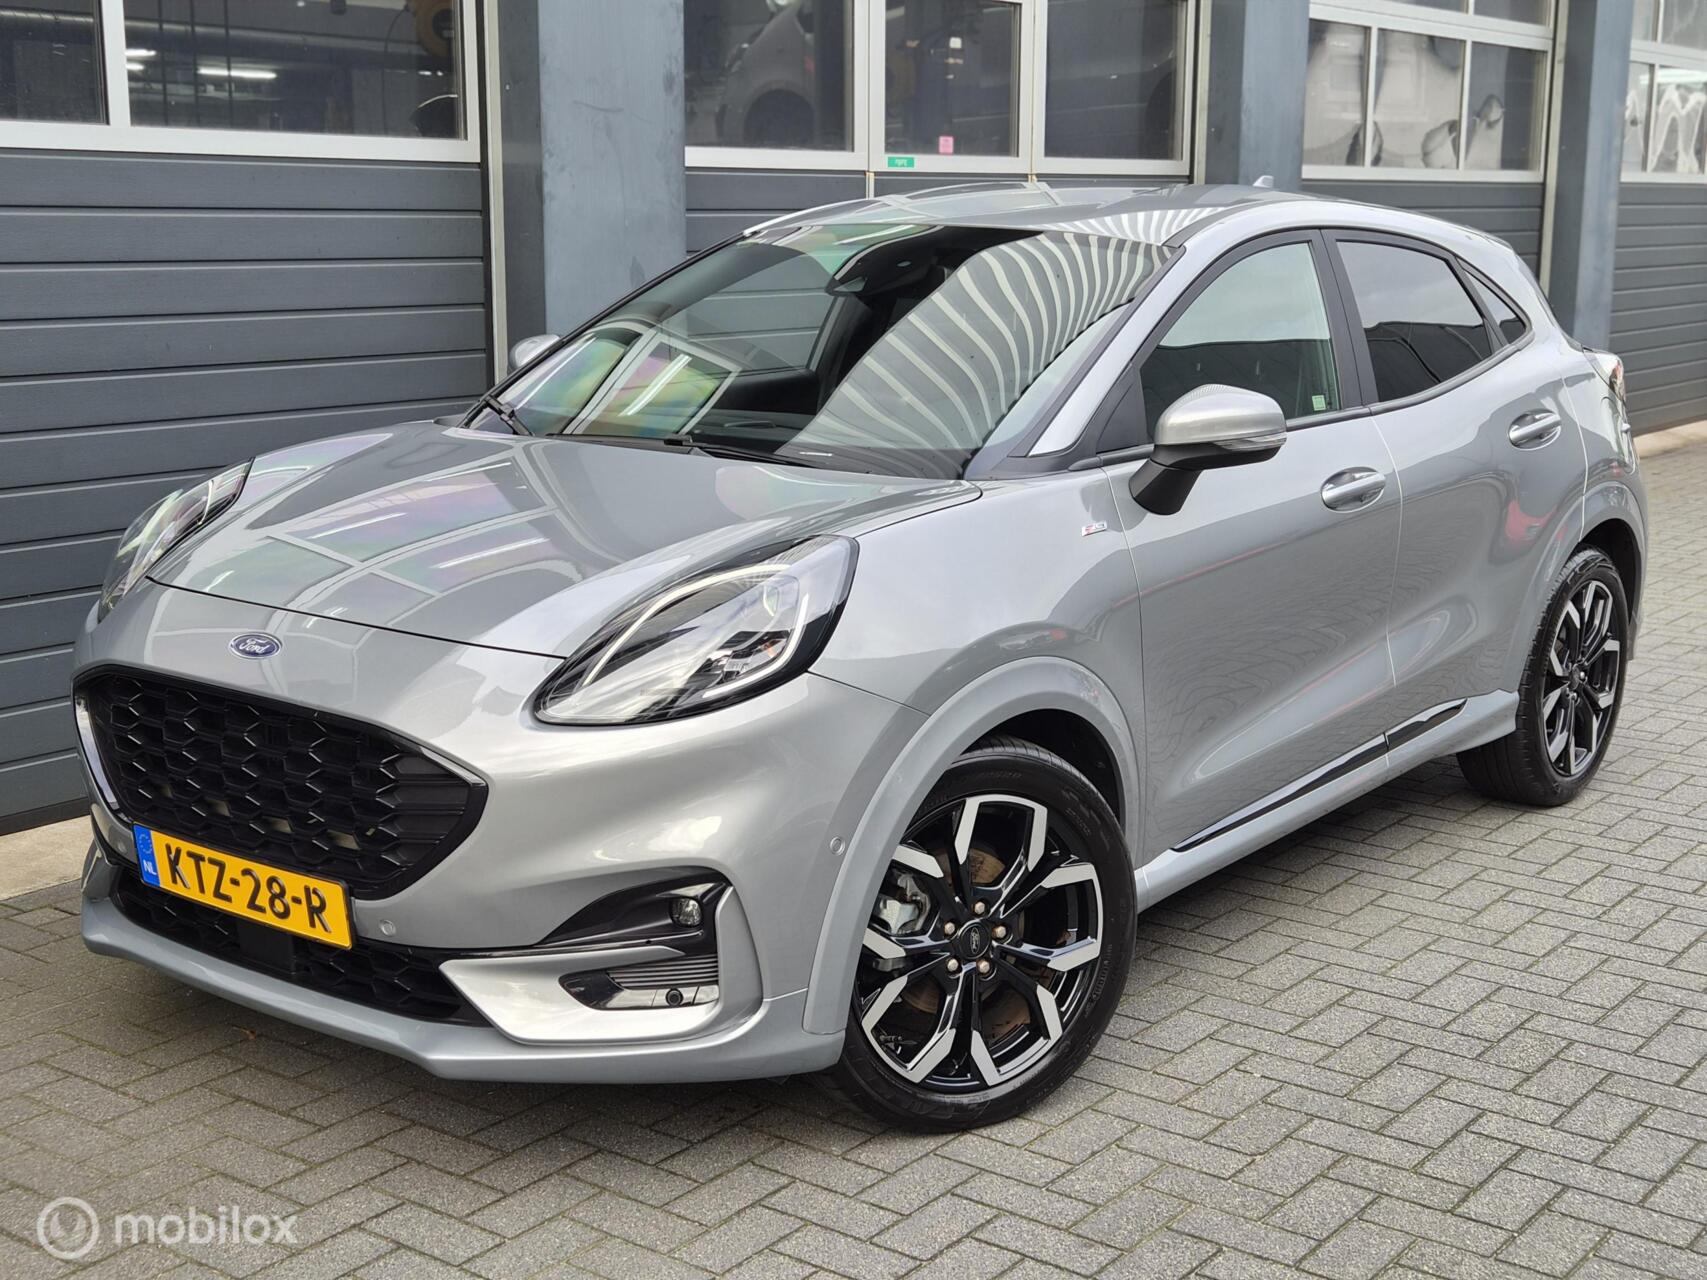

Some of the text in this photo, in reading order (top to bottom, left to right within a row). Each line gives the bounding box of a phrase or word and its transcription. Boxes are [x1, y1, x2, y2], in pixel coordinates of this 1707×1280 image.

[238, 637, 271, 654] Ford
[142, 858, 158, 876] NL
[165, 842, 333, 934] KTZ-28-R
